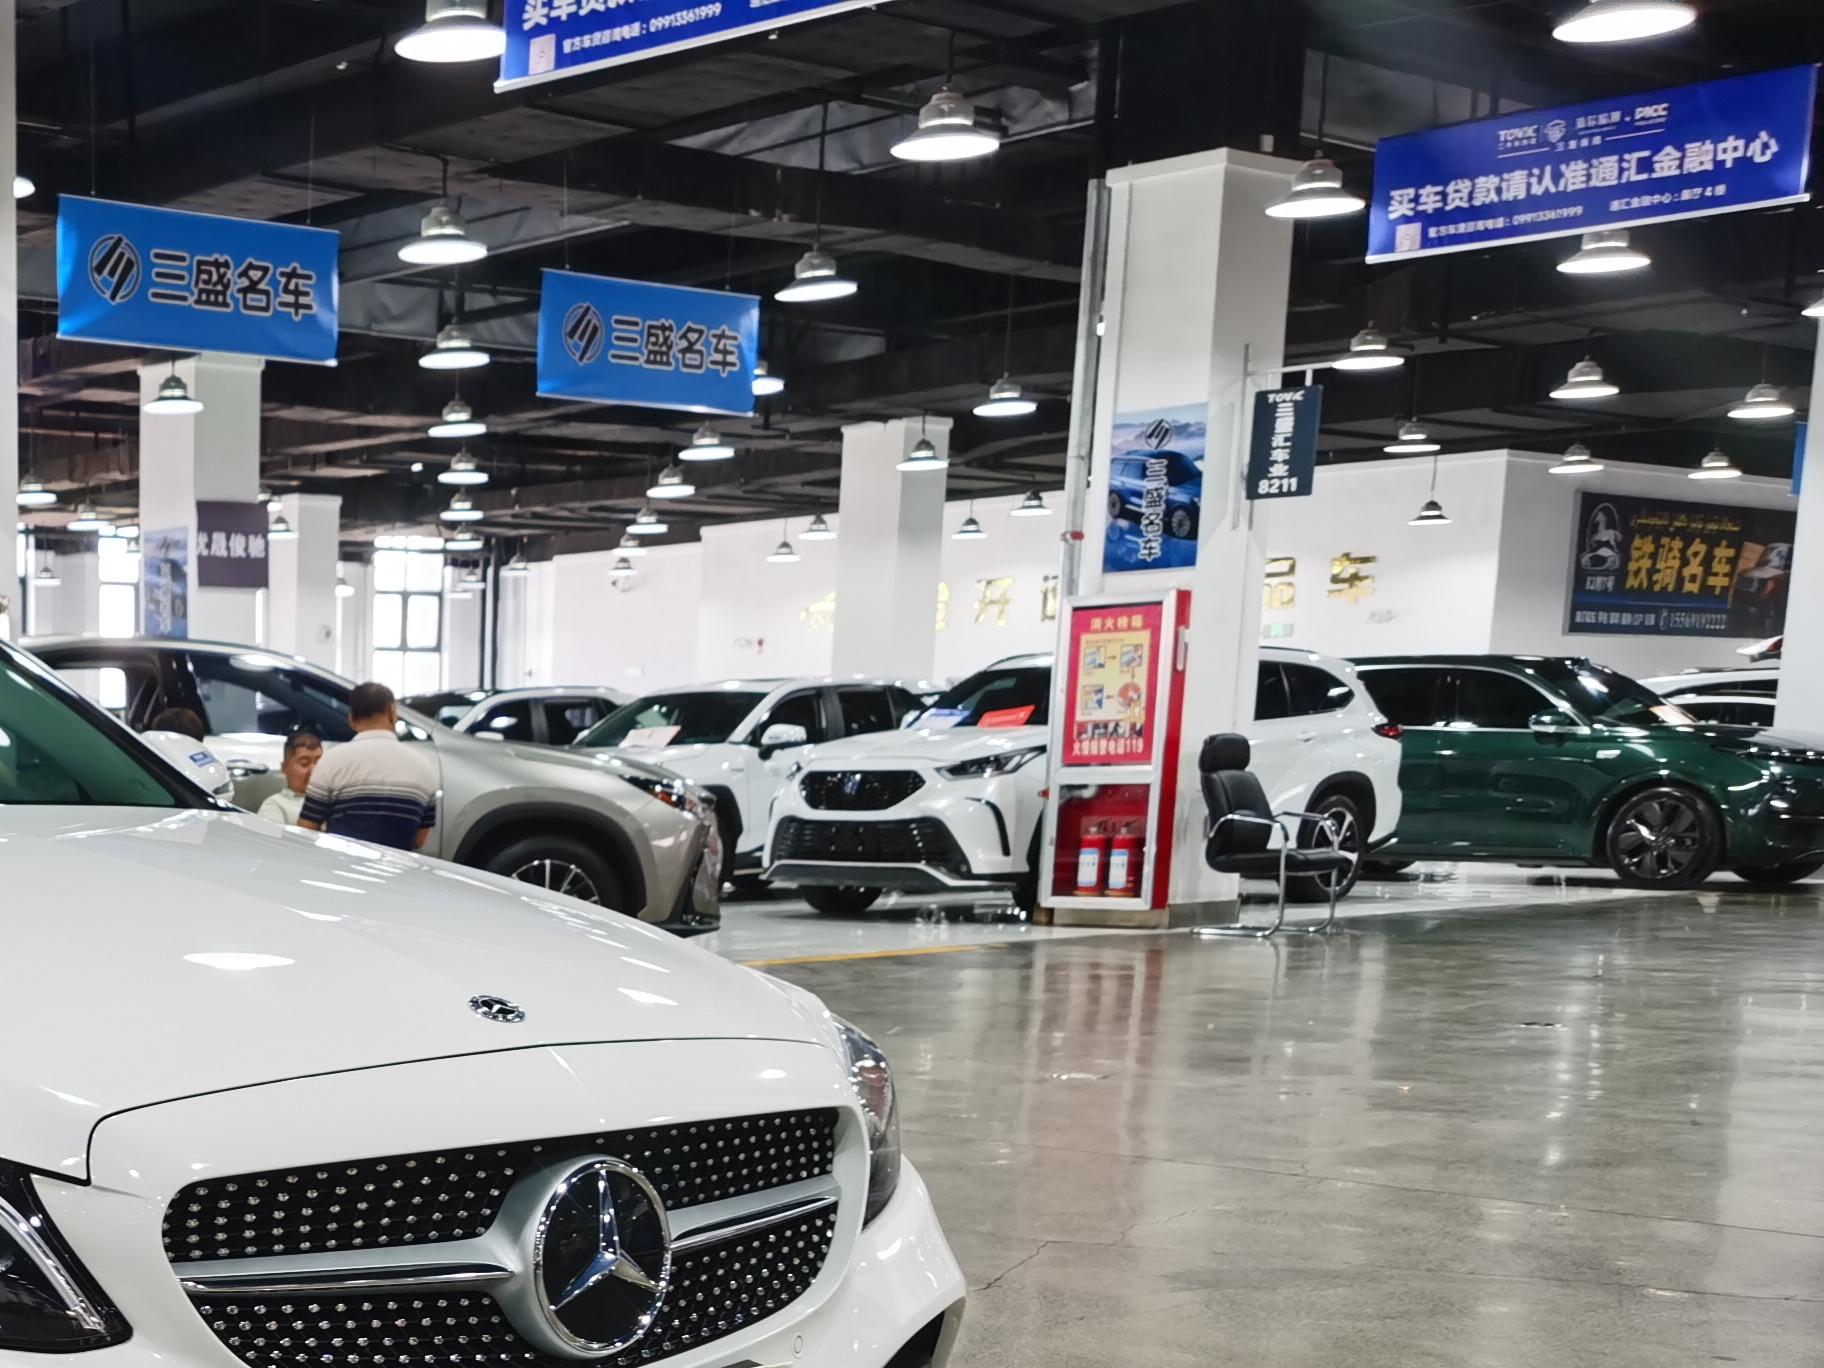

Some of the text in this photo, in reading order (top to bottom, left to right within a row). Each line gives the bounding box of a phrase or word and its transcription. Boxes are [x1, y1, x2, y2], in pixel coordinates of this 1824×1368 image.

[1387, 131, 1779, 219] 买车贷款请认准通汇金融中心
[148, 249, 316, 321] 三盛名车
[608, 315, 740, 377] 三盛名车
[1138, 458, 1167, 561] 三盛名车
[1257, 477, 1298, 495] 8211
[1626, 534, 1735, 595] 铁骑名车
